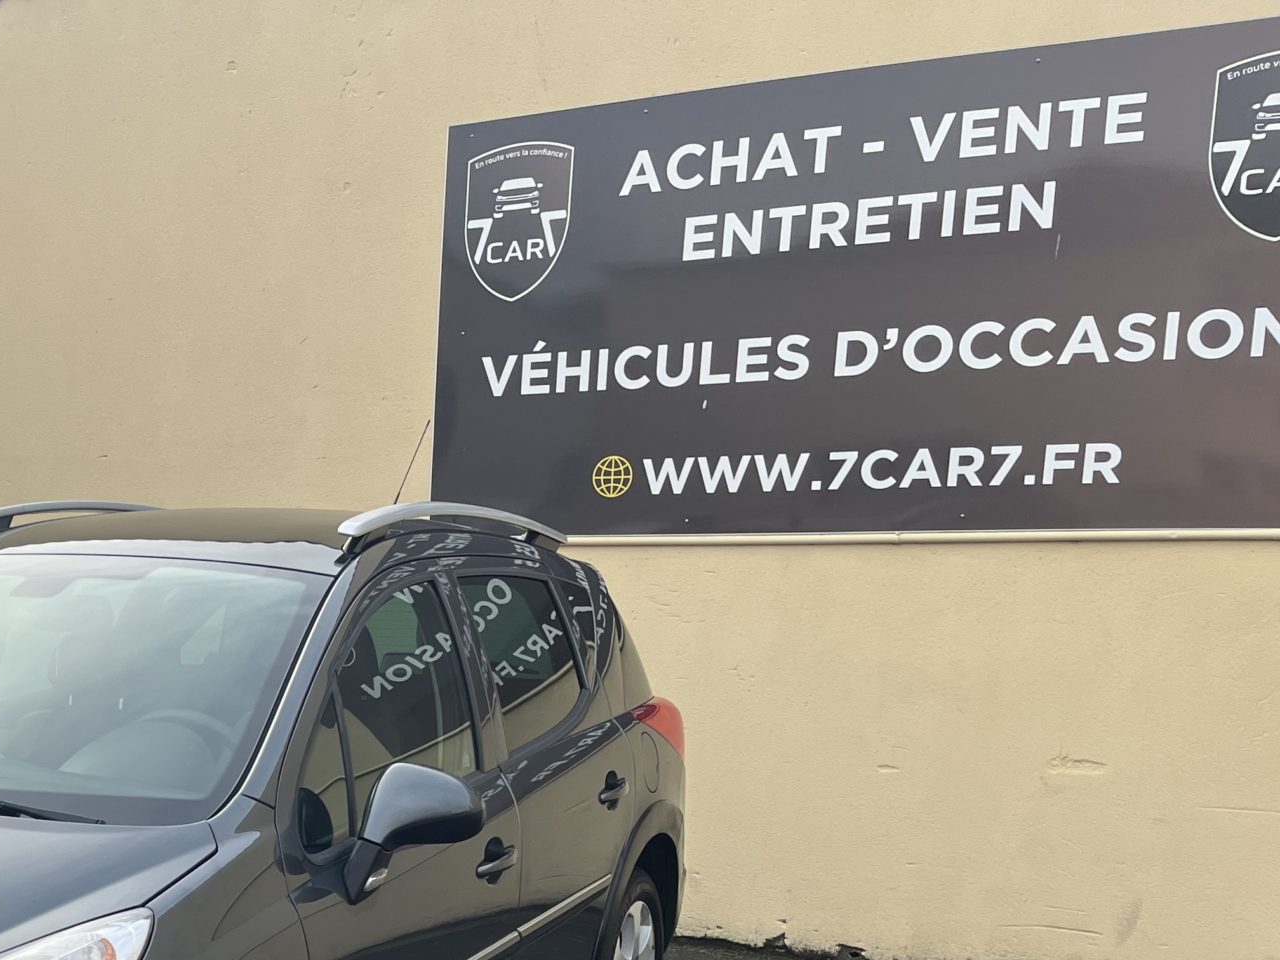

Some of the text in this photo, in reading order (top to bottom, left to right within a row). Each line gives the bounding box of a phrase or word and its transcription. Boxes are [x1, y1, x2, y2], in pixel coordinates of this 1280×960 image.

[1227, 71, 1240, 80] En
[1242, 62, 1271, 75] route
[475, 161, 485, 170] En
[485, 154, 505, 166] route
[506, 150, 520, 159] vers
[521, 148, 529, 156] la
[529, 148, 564, 158] confiance
[619, 126, 842, 197] ACHAT
[910, 92, 1149, 163] VENTE
[681, 181, 1057, 262] ENTRETIEN
[481, 307, 1280, 397] VÉHICULES D'OCCASION
[642, 442, 1122, 495] WWW.7CAR7.FR
